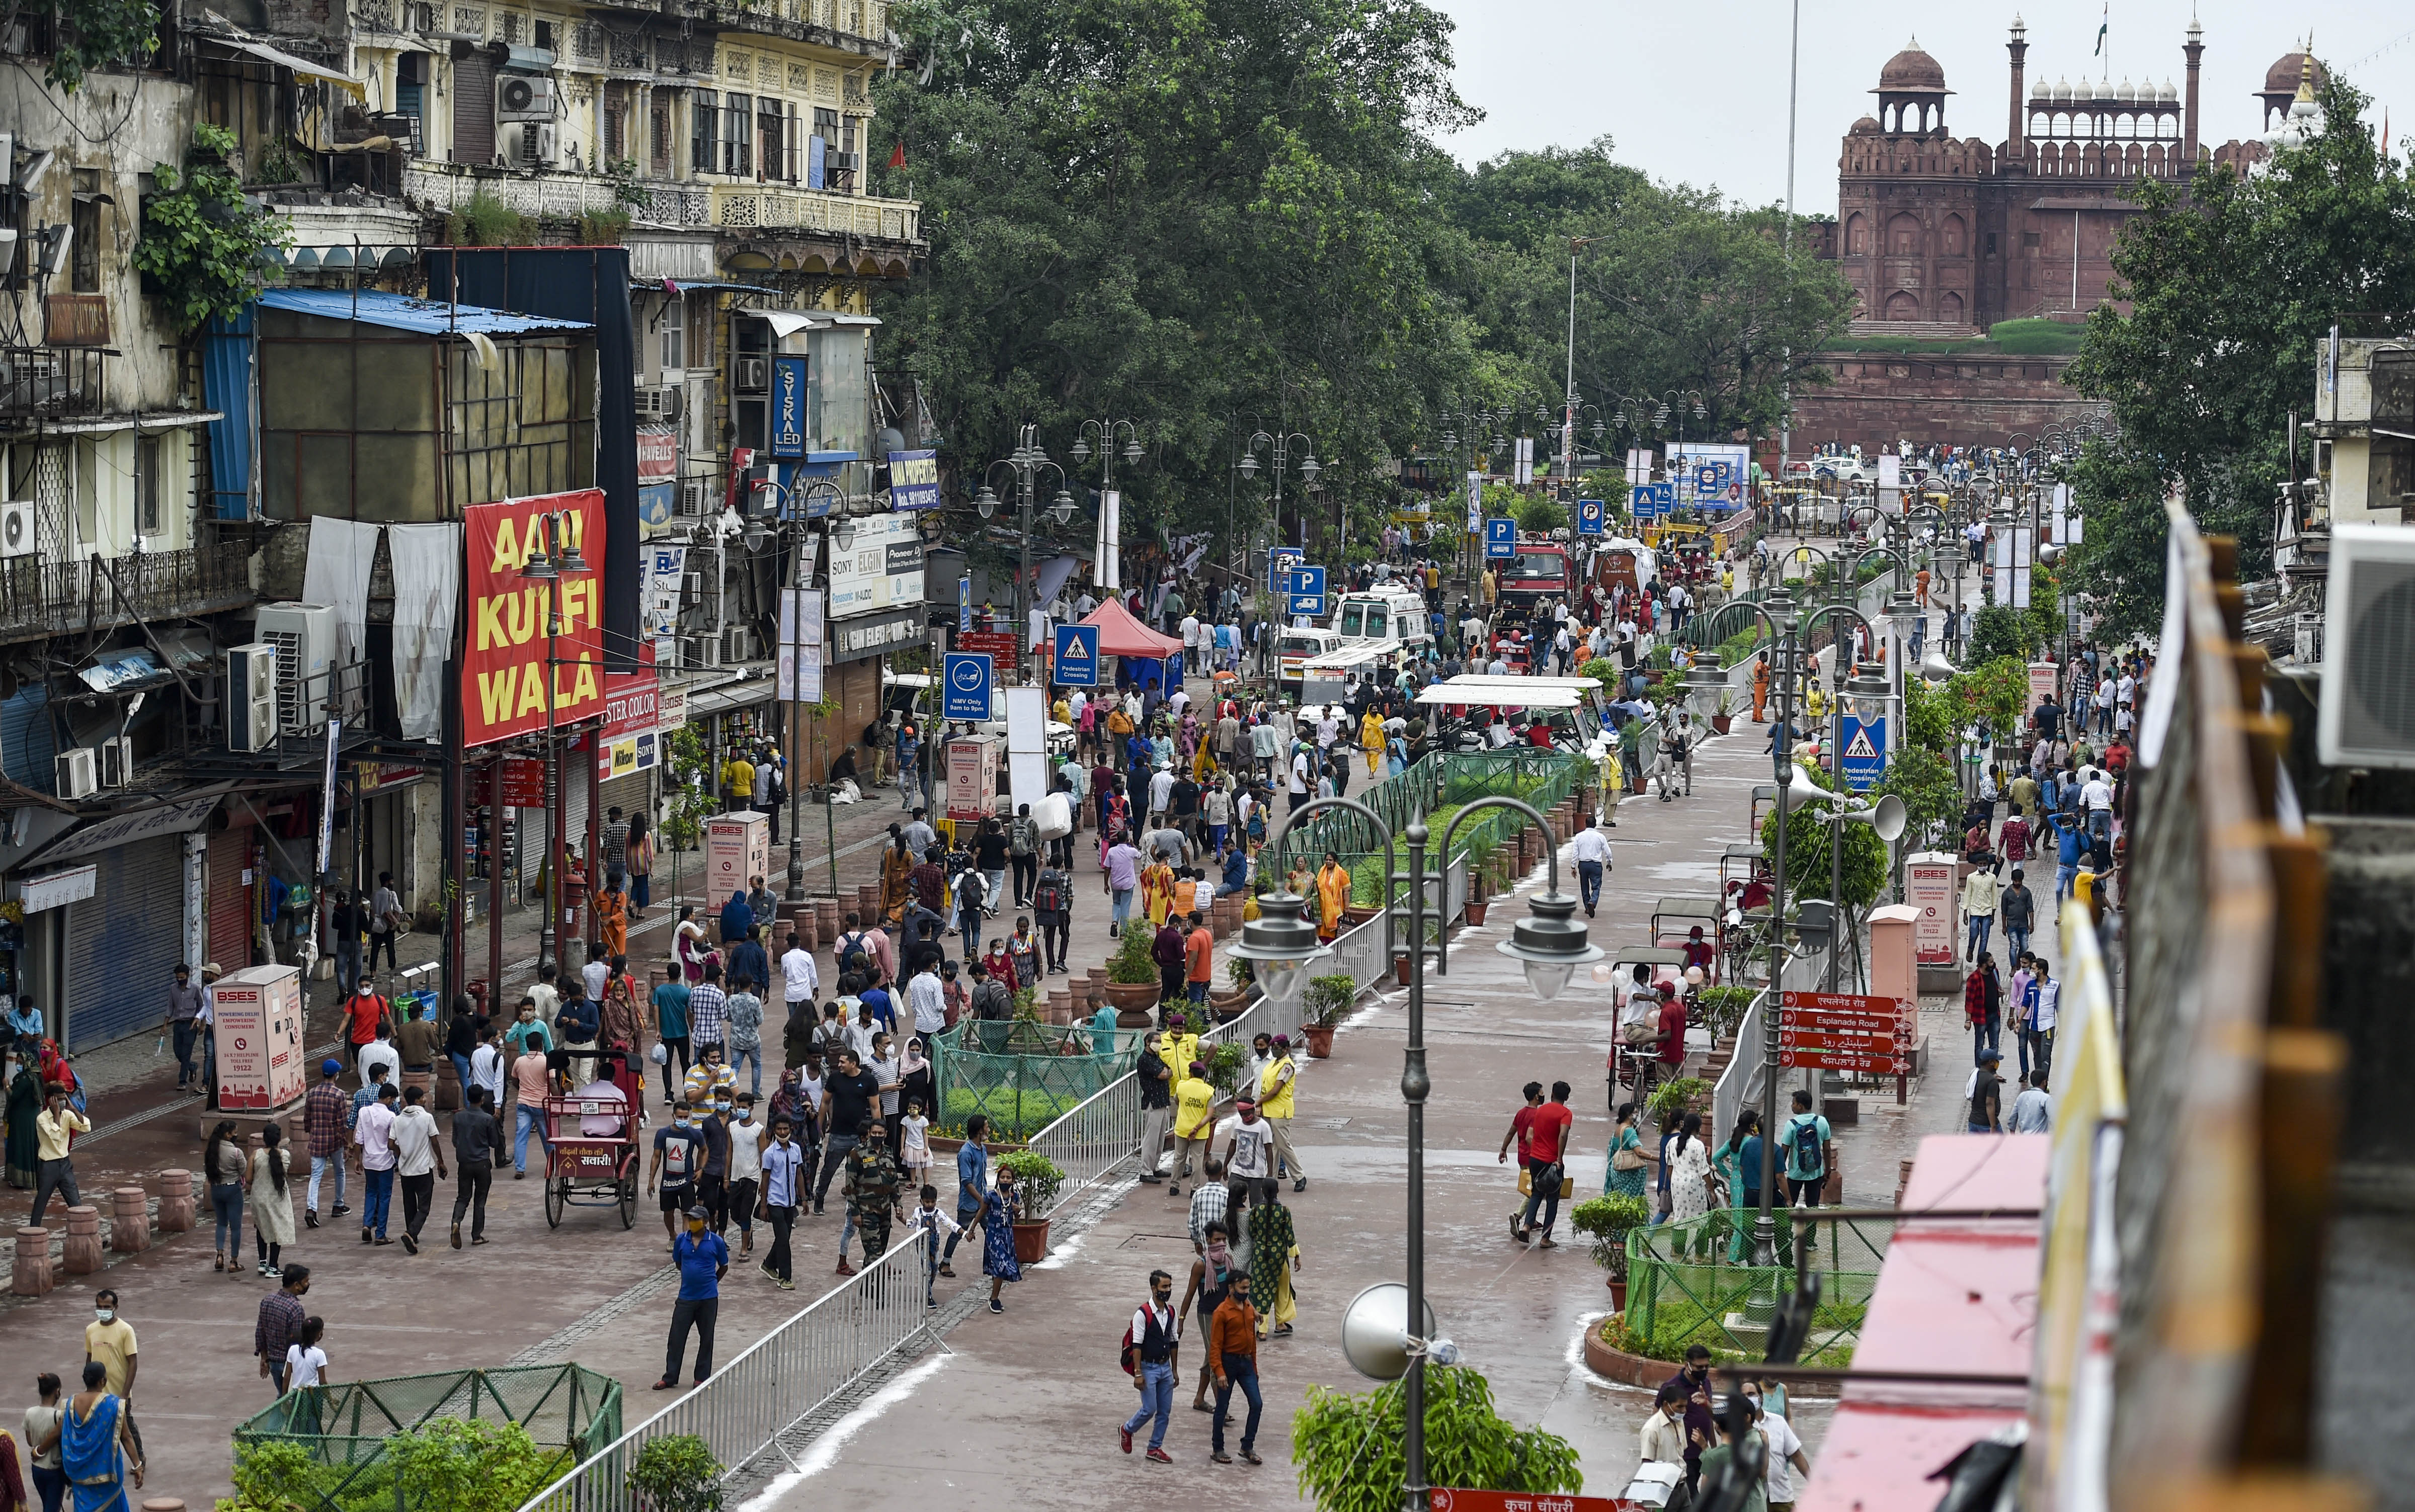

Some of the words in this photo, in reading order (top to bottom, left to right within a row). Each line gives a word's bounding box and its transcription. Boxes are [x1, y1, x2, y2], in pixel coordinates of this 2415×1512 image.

[775, 433, 801, 445] LED
[641, 445, 673, 461] HAVELLS
[890, 460, 906, 487] RANA
[905, 458, 938, 486] PROPERTIES
[897, 492, 909, 507] Mob.
[909, 489, 936, 506] 9811093475
[1497, 524, 1506, 538] P
[889, 549, 913, 559] Pioneer
[833, 560, 852, 575] SONY
[858, 552, 881, 573] ELGIN
[1302, 572, 1314, 590] P
[832, 591, 853, 604] Panasonic
[855, 589, 871, 602] M-AUDIO
[477, 578, 597, 651] KULFI
[477, 651, 598, 726] WALA
[601, 700, 627, 724] STER
[628, 693, 655, 718] COLOR
[665, 694, 683, 710] BOSS
[659, 713, 683, 727] ROTHERS
[637, 743, 654, 758] SONY
[599, 758, 609, 769] non
[615, 749, 633, 768] Nikon
[217, 991, 257, 1001] BSES
[1817, 996, 1850, 1006] एस्पलेनेड
[1853, 998, 1866, 1007] रोड
[1817, 1017, 1856, 1026] Esplanade
[1858, 1020, 1879, 1028] Road
[1822, 1036, 1835, 1048] روڈ
[271, 1051, 288, 1067] BSES
[579, 1147, 592, 1156] चौक
[594, 1147, 604, 1155] की
[581, 1153, 611, 1166] सवारी!
[663, 1177, 687, 1187] Reebok
[1504, 1499, 1533, 1511] कूचा
[1537, 1498, 1574, 1511] चौधरी
